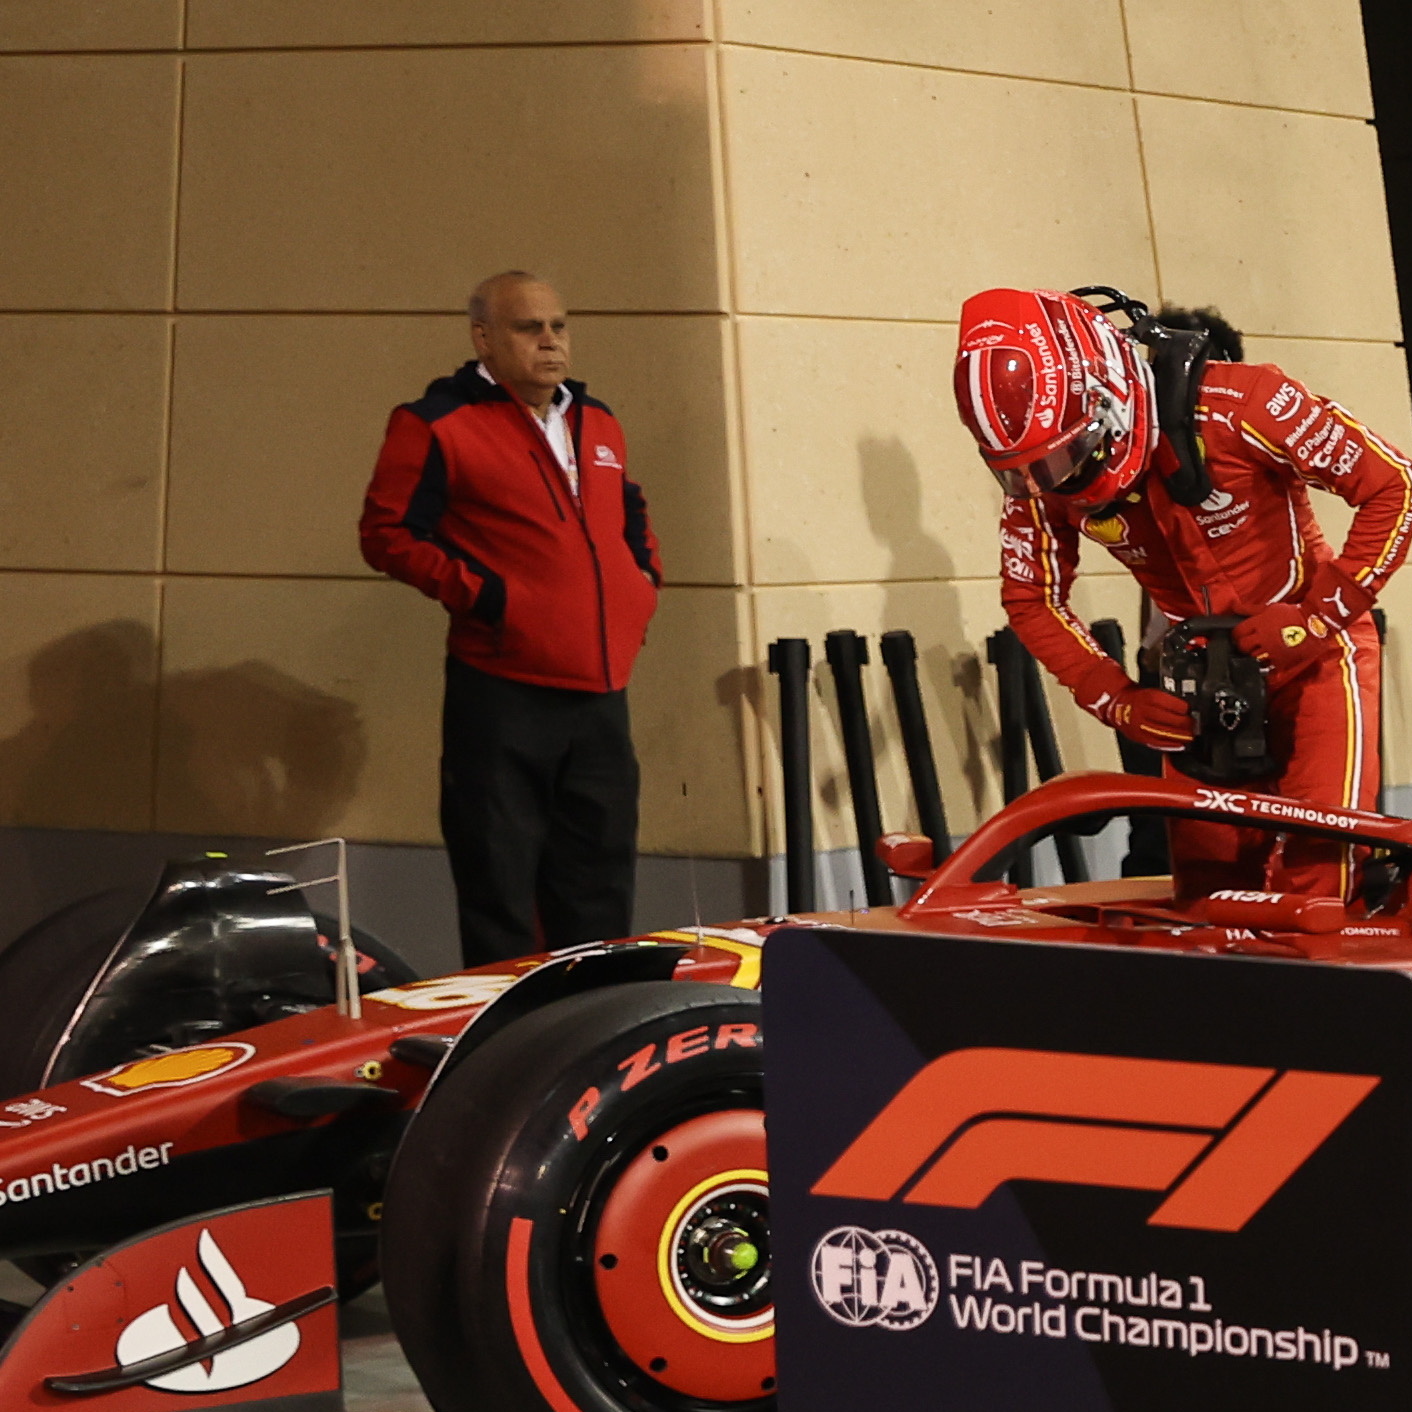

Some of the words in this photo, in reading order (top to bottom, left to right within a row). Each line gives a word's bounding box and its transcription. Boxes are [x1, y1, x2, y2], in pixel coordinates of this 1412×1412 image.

[1025, 323, 1058, 406] Santander
[1266, 382, 1297, 417] aws
[1196, 501, 1250, 526] Santander
[1250, 799, 1359, 829] TECHNOLOGY
[617, 1023, 759, 1092] ZER
[948, 1253, 1013, 1293] FIA
[1022, 1260, 1182, 1307] Formula
[1186, 1275, 1212, 1311] 1
[949, 1294, 1067, 1338] World
[1075, 1304, 1359, 1371] Championship
